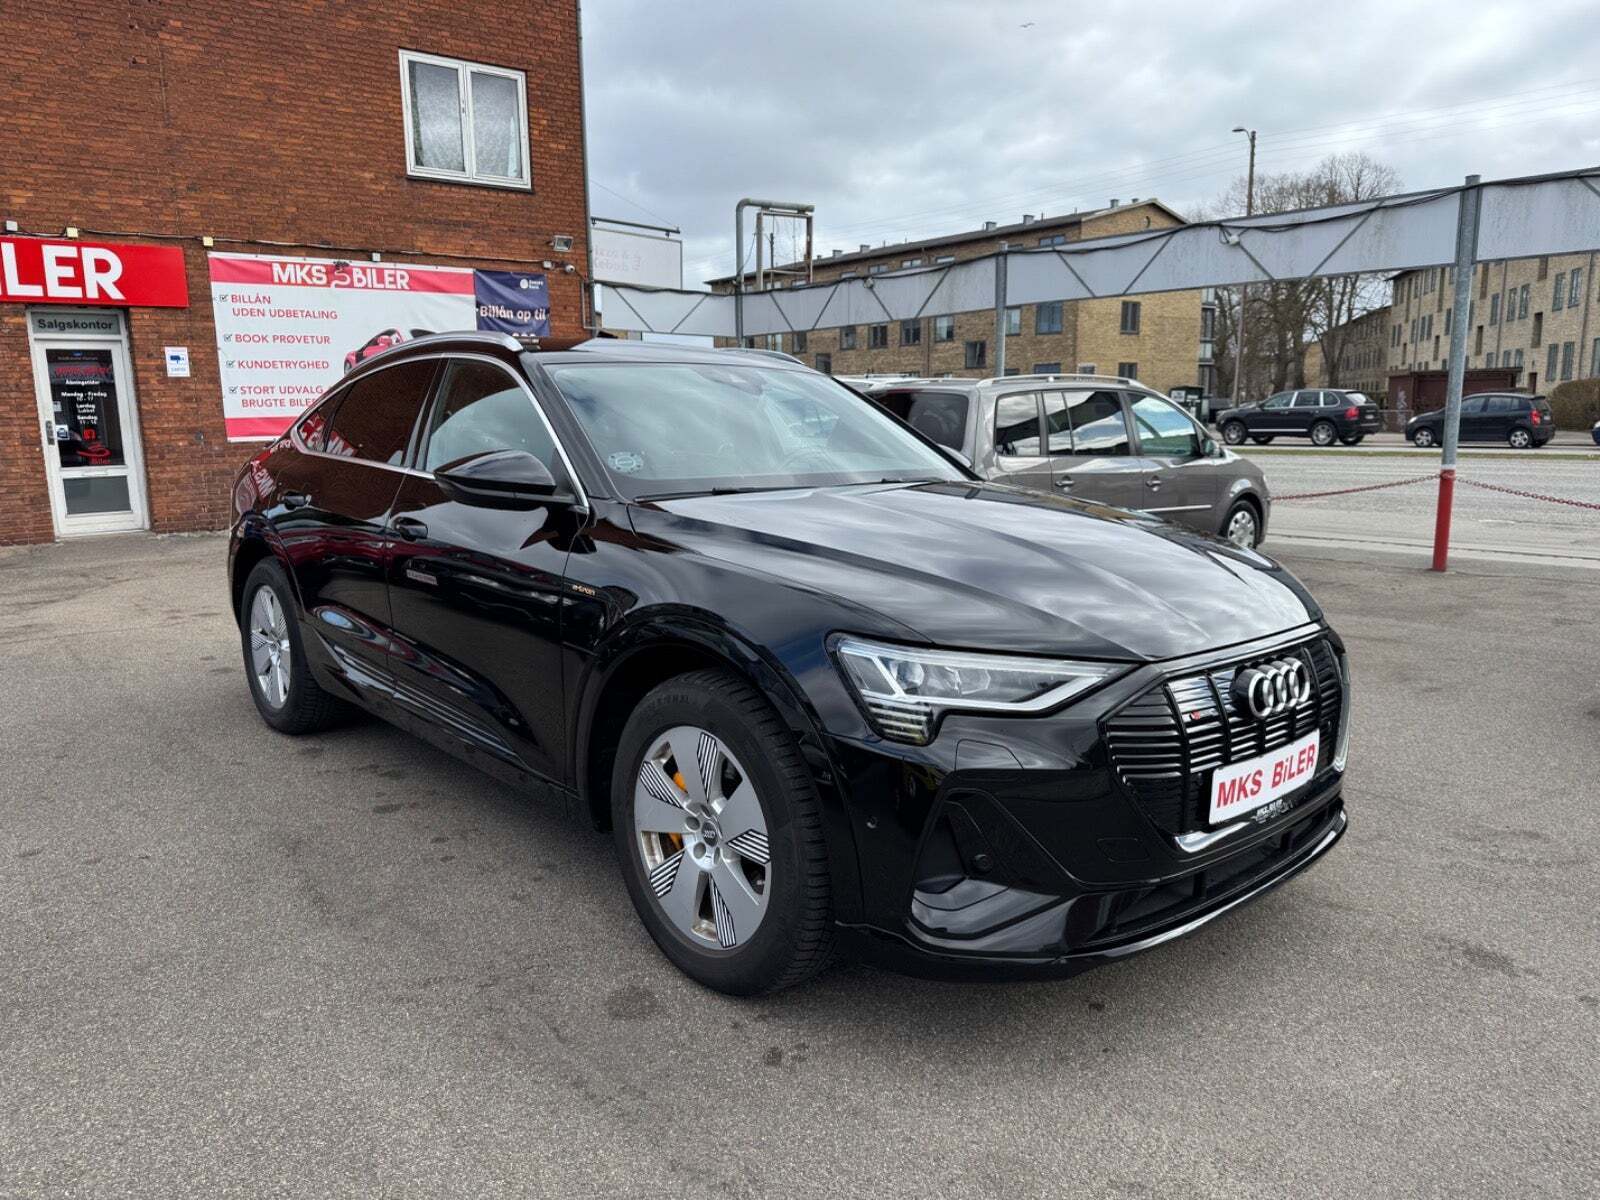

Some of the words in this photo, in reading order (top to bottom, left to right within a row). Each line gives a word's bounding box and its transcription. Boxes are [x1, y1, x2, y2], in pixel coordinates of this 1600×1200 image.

[0, 244, 126, 300] LER
[271, 263, 327, 285] MKS
[352, 268, 410, 290] BILER
[231, 293, 271, 304] BILLÅN
[232, 307, 265, 318] UDEN
[269, 309, 338, 320] UDBETALING
[480, 305, 514, 319] Billån
[517, 310, 531, 323] op
[535, 308, 546, 320] til
[37, 318, 113, 331] Salgskontor
[235, 334, 269, 344] BOOK
[273, 335, 331, 345] PRØVETUR
[238, 360, 330, 370] KUNDETRYGHED
[240, 385, 275, 395] STORT
[279, 385, 324, 395] UDVALG
[242, 398, 286, 408] BRUGTE
[1216, 769, 1264, 809] MKS
[1271, 744, 1316, 789] BiLER
